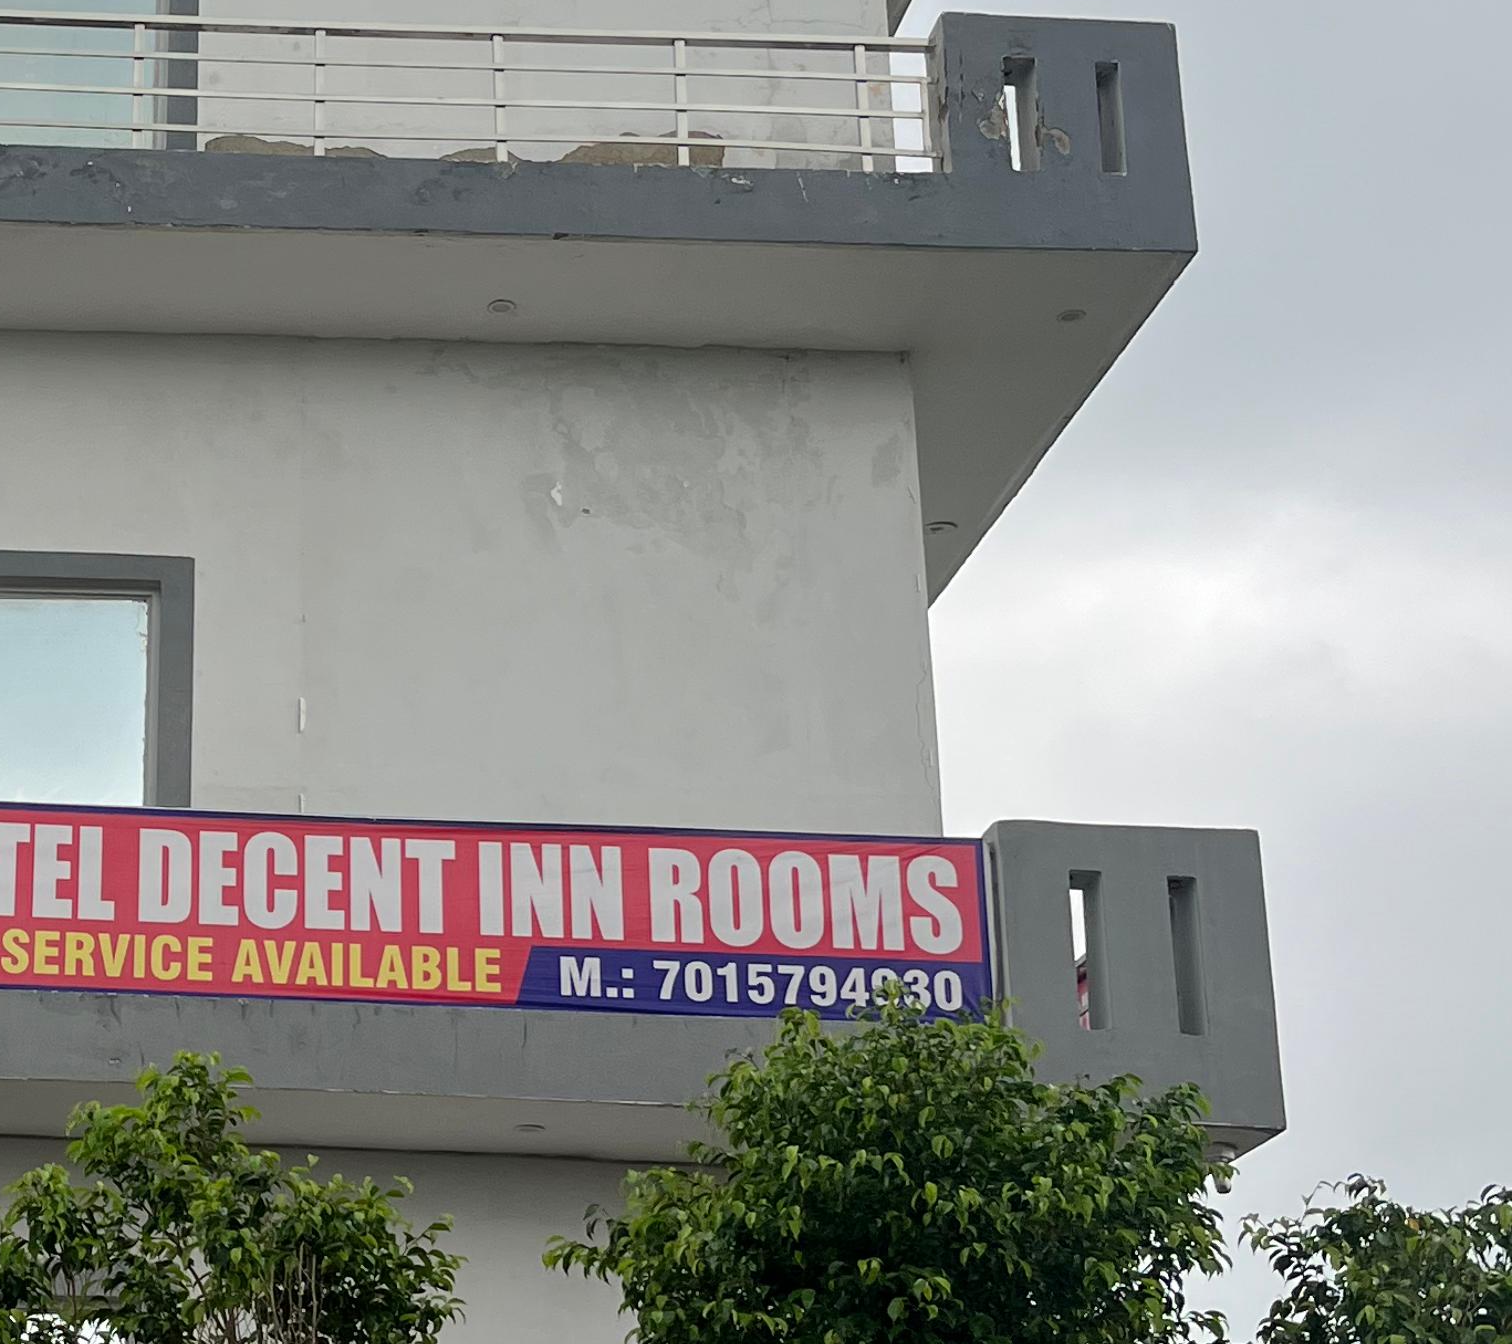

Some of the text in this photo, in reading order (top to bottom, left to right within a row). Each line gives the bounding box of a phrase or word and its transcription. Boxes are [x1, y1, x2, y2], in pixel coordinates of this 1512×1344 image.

[138, 827, 455, 934] DECENT
[479, 841, 624, 941] INN
[648, 847, 963, 955] ROOMS
[1, 928, 213, 981] SERVICE
[231, 938, 501, 993] AVAILABLE
[559, 956, 963, 1012] M.: 7015794930
